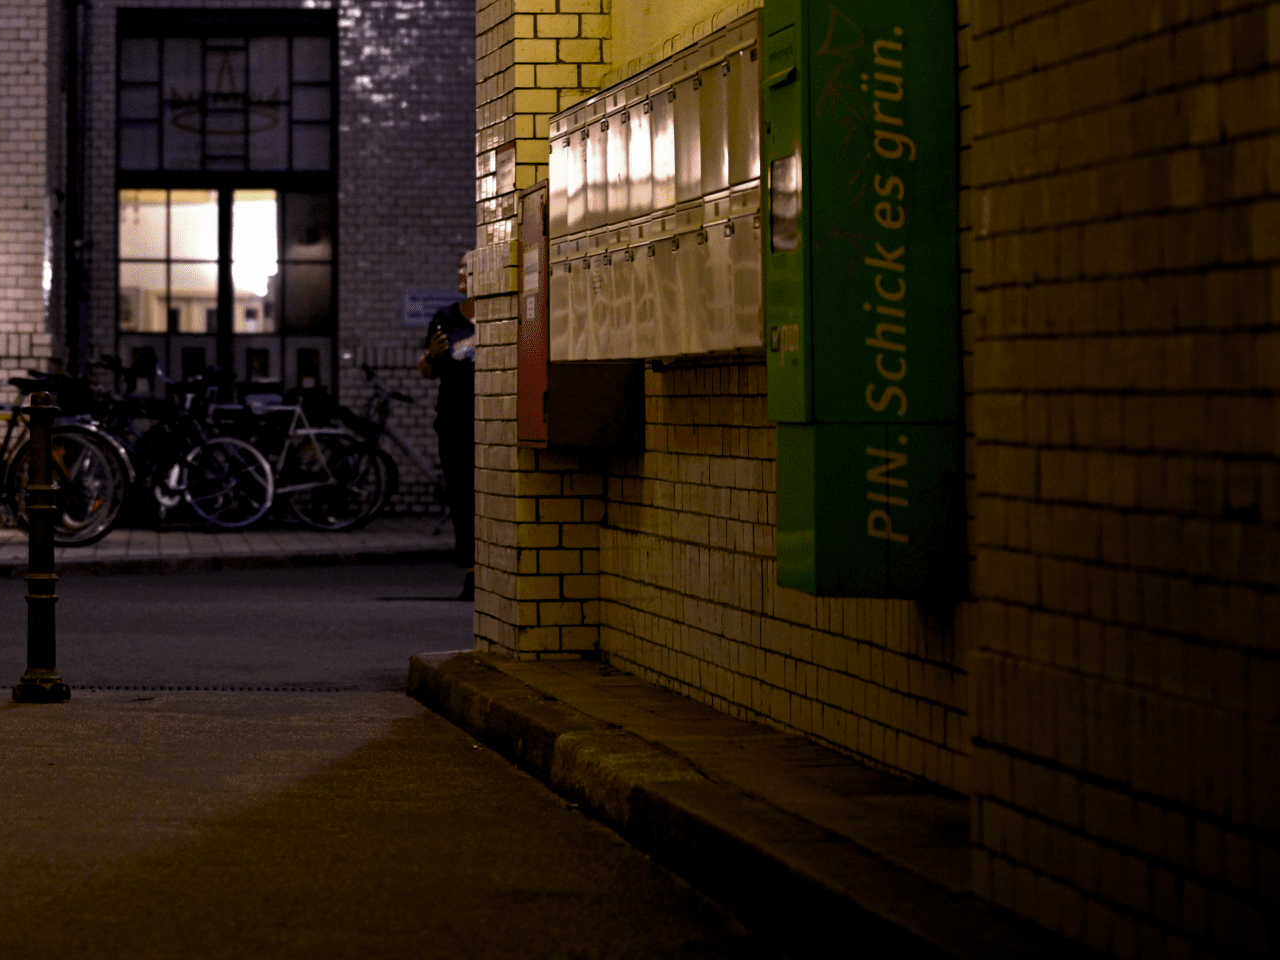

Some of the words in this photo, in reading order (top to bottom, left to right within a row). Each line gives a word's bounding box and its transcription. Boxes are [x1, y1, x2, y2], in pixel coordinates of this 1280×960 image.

[860, 25, 918, 162] grün.
[873, 173, 907, 231] es
[863, 240, 909, 418] Schick
[866, 434, 910, 544] PIN.
